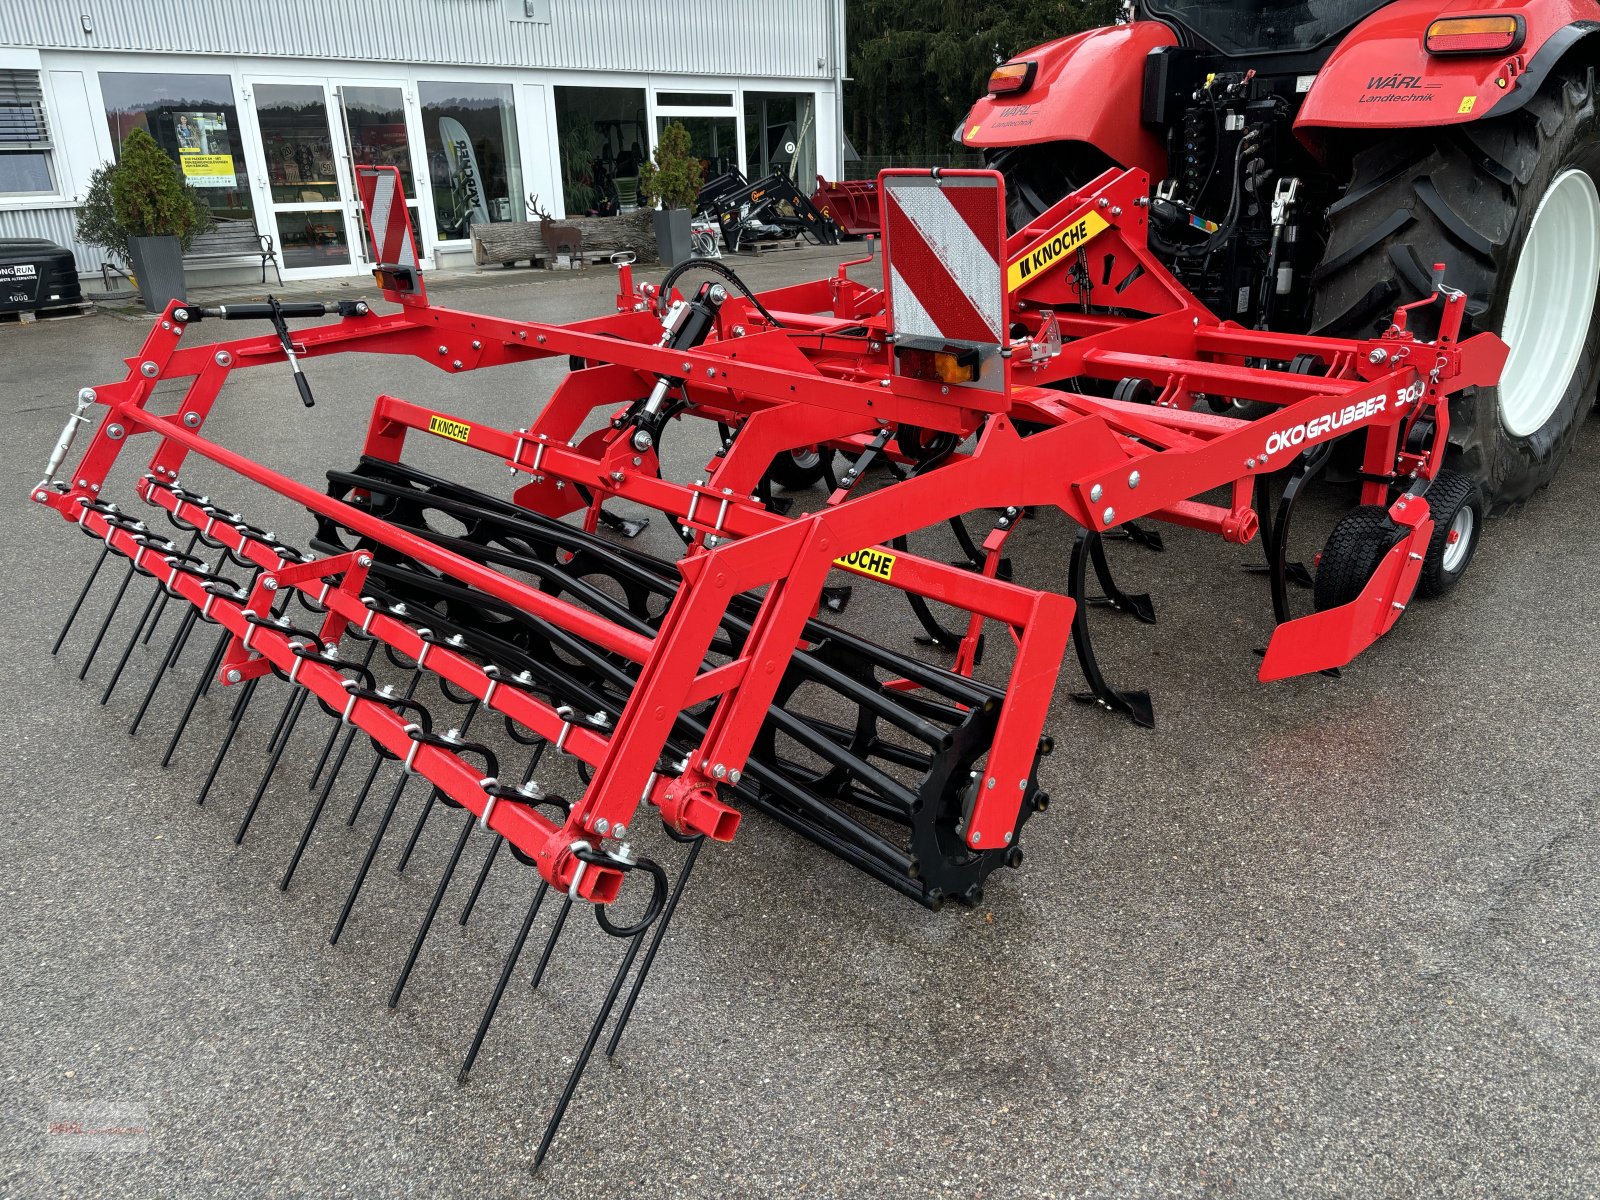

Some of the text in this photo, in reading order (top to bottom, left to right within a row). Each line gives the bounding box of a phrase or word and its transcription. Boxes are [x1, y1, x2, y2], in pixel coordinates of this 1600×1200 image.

[1367, 74, 1422, 90] WÄRL
[1359, 93, 1434, 103] Landtechnik
[1032, 221, 1088, 270] KNOCHE
[16, 266, 34, 274] RUN
[9, 294, 28, 302] 1000
[1394, 380, 1426, 408] 300
[436, 420, 469, 440] KNOCHE
